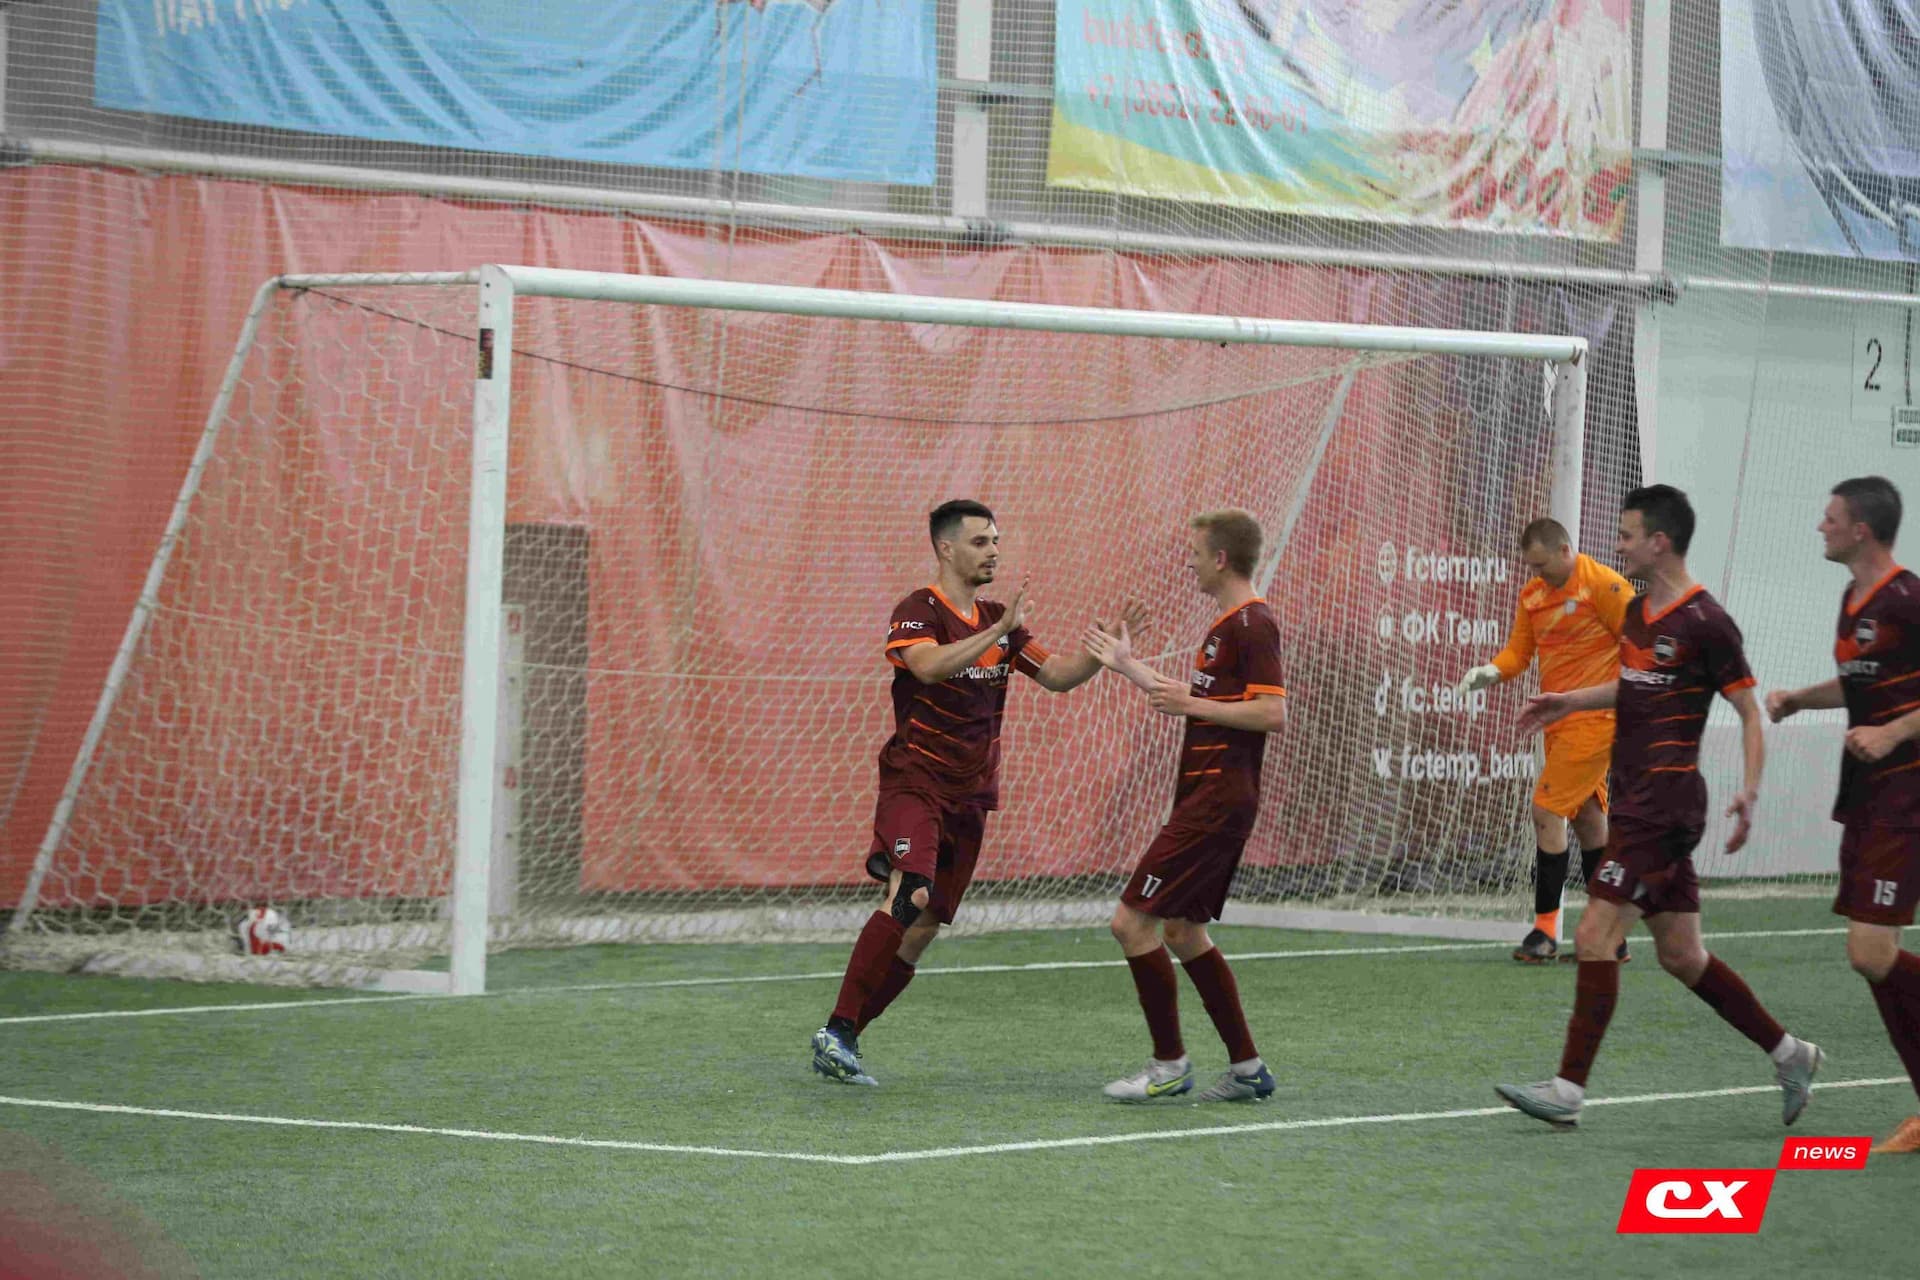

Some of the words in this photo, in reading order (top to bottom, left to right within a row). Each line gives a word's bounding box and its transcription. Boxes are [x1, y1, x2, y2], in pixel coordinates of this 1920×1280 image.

[1864, 338, 1882, 391] 2
[1405, 545, 1506, 590] fctemp.ru
[1403, 610, 1440, 645] ФК
[1445, 611, 1499, 645] Темп
[1141, 874, 1163, 898] 17
[1598, 861, 1625, 887] 24
[1873, 879, 1898, 906] 15
